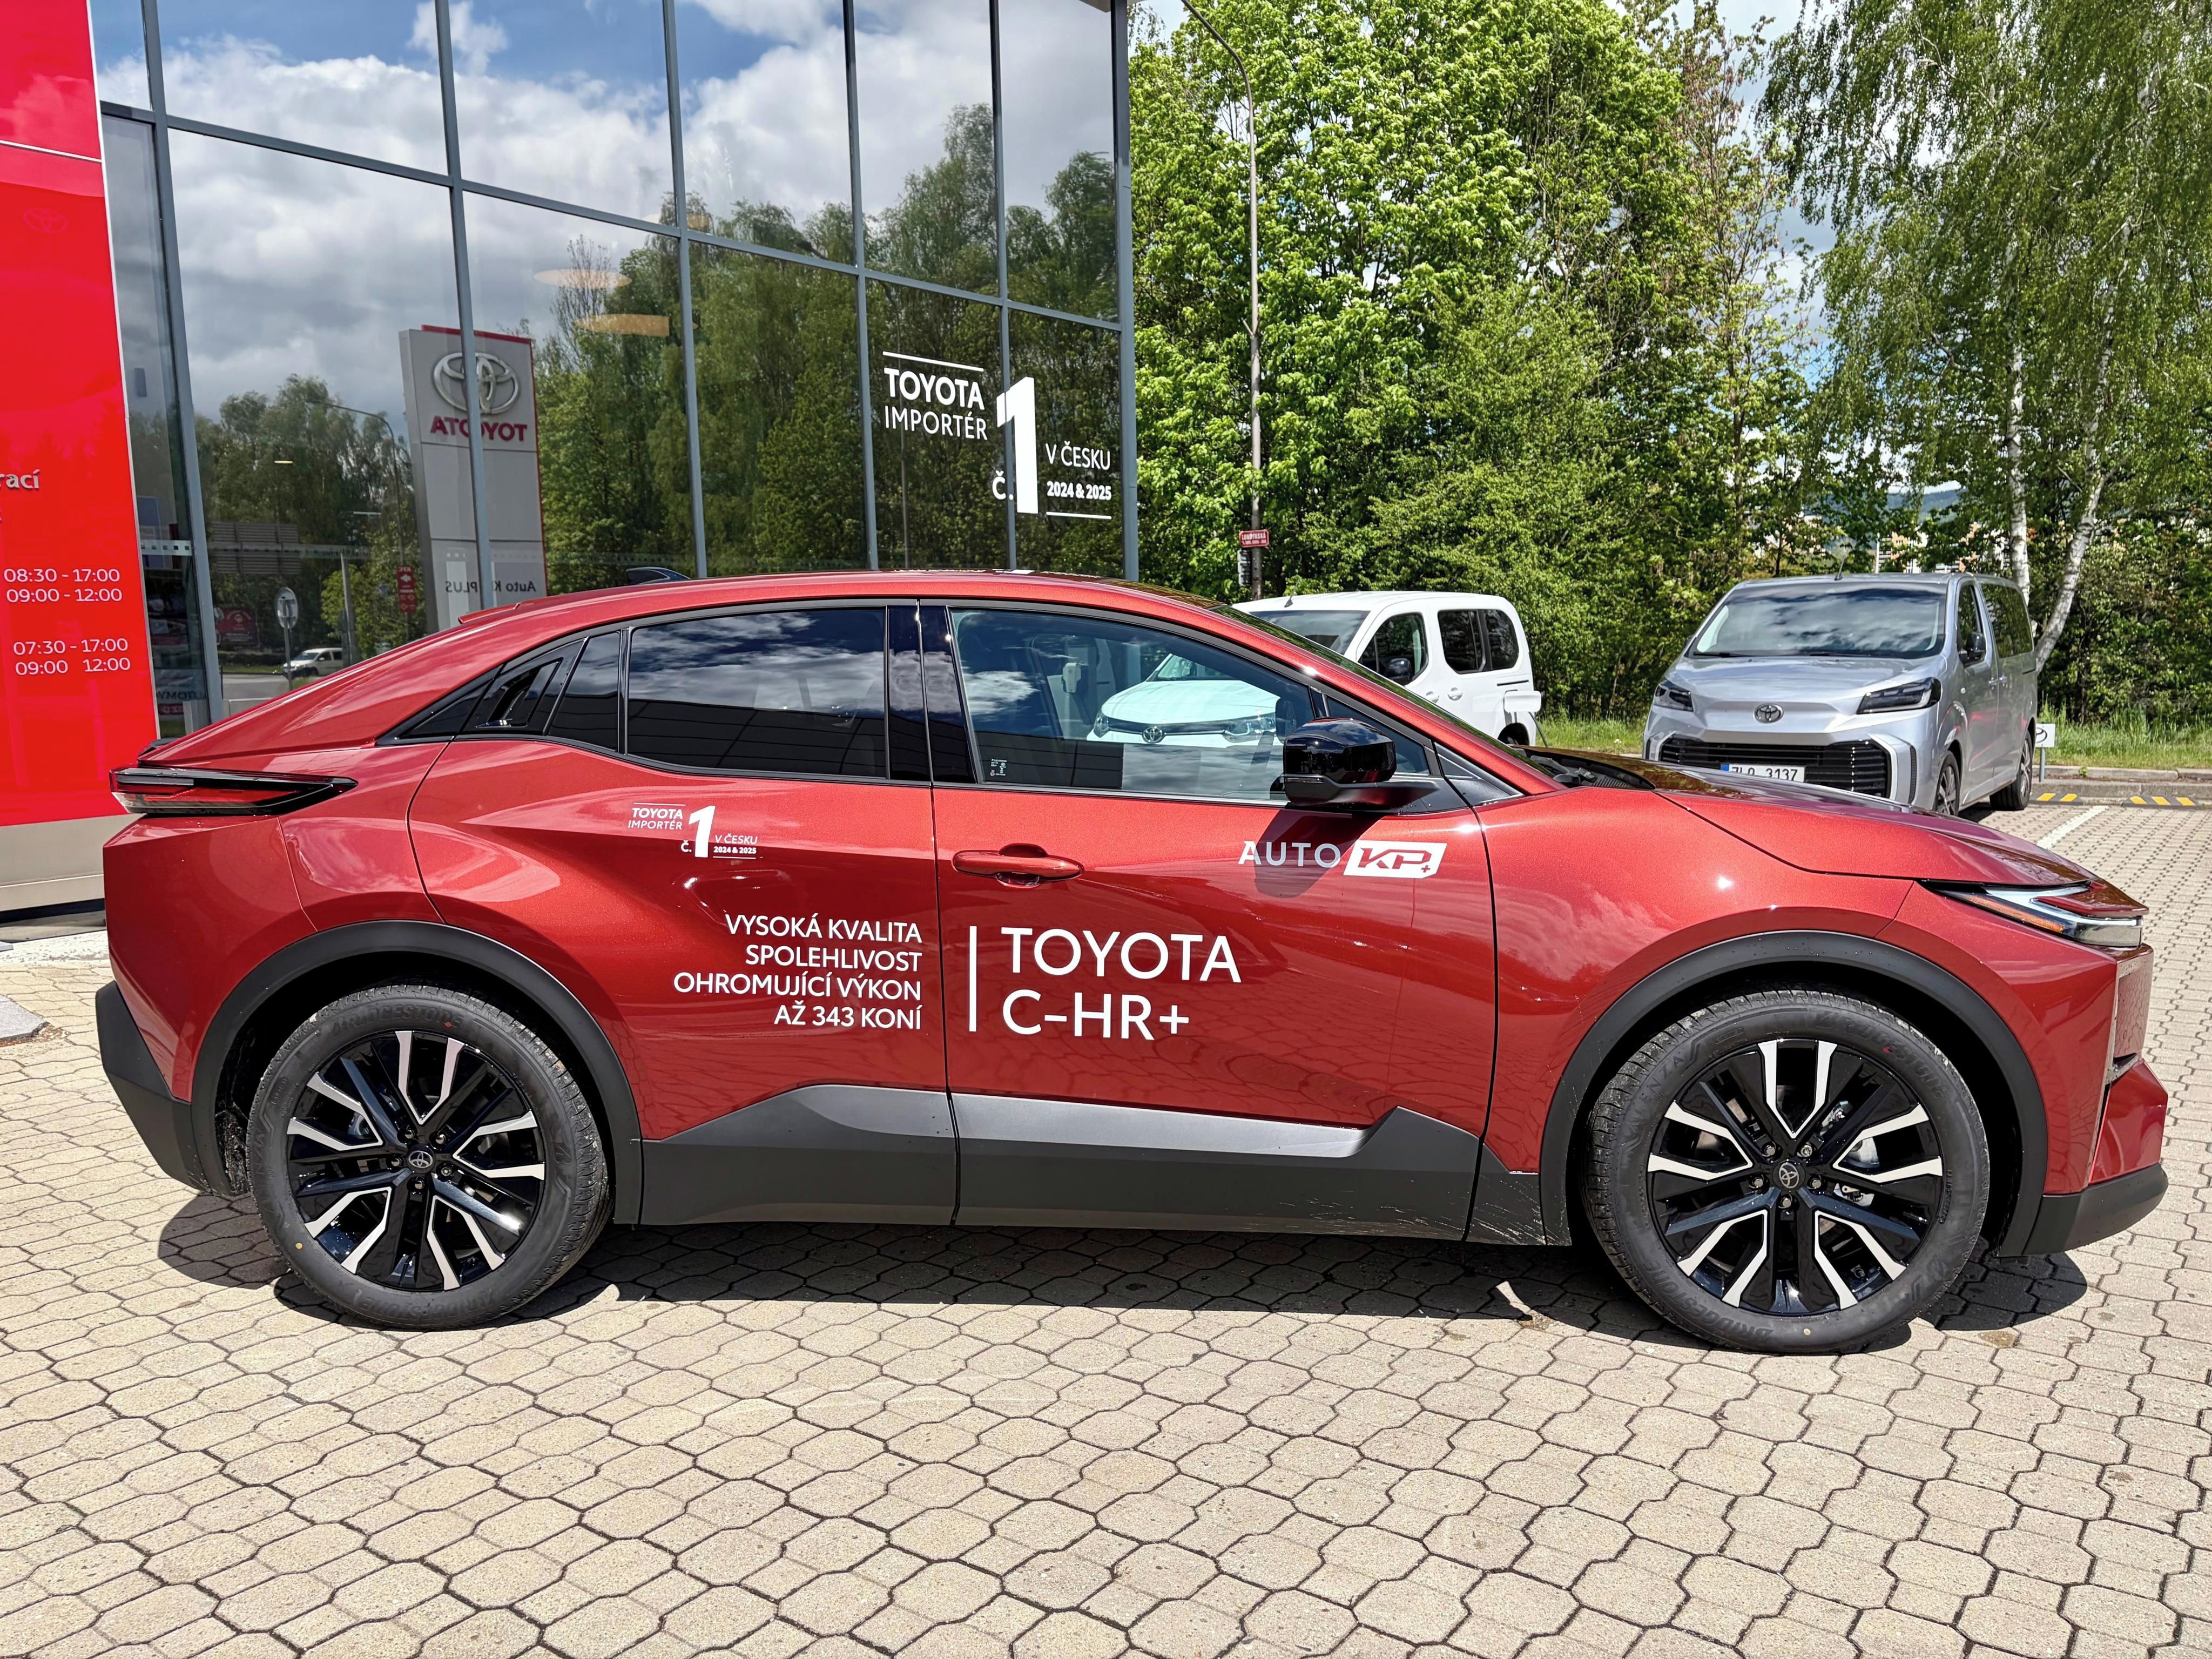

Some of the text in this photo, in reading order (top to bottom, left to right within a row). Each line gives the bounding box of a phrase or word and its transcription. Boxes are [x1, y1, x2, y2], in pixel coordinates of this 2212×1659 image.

[884, 367, 984, 410] TOYOTA
[885, 406, 987, 440] IMPORTÉR
[996, 377, 1038, 514] 1
[1046, 441, 1110, 470] V ČESKU
[4, 568, 57, 583] 08:30
[72, 569, 120, 582] 17:00
[6, 588, 60, 603] 09:00
[75, 588, 123, 602] 12:00
[13, 640, 66, 656] 07:30
[81, 638, 129, 652] 17:00
[15, 657, 131, 676] 09:00 12:00
[1766, 768, 1798, 781] 3137
[628, 820, 682, 830] IMPORTÉR
[632, 807, 683, 820] TOYOTA
[689, 806, 716, 858] 1
[715, 833, 758, 845] V ČESKU
[1238, 841, 1341, 868] AUTO
[725, 913, 922, 943] VYSOKÁ KVALITA
[745, 945, 922, 972] SPOLEHLIVOST
[1001, 927, 1242, 983] TOYOTA
[673, 971, 921, 1001] OHROMUJÍCÍ VÝKON
[774, 1000, 923, 1029] AŽ 343 KONÍ
[1002, 989, 1190, 1041] C-HR+
